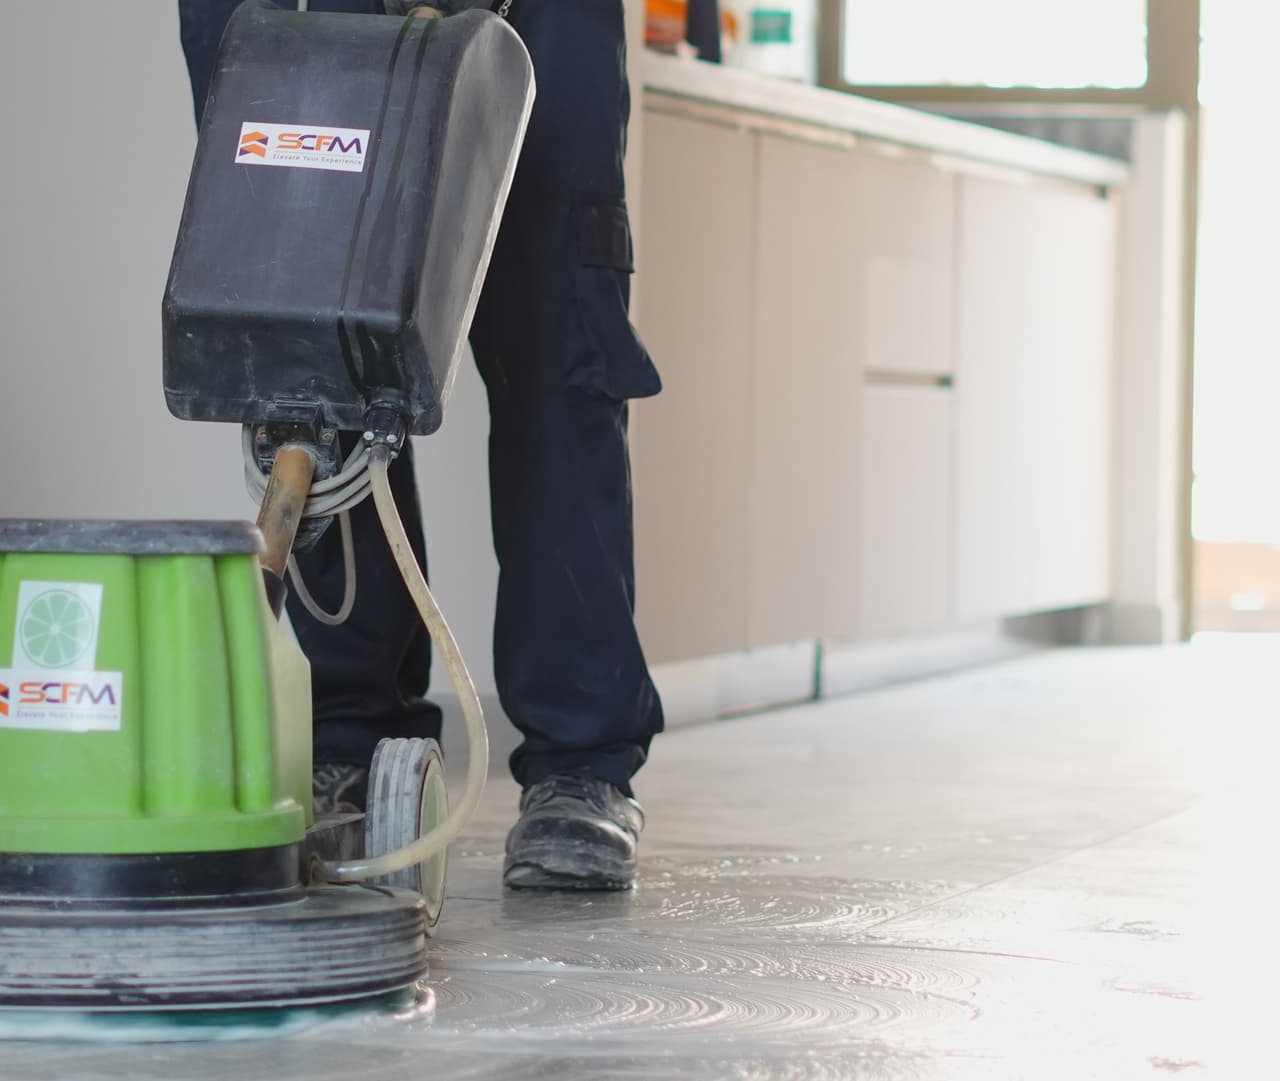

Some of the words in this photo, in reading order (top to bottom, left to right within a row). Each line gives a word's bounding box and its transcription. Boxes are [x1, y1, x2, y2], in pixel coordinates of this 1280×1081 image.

[276, 132, 362, 154] SCFM
[272, 153, 301, 161] Elevate
[321, 156, 362, 166] Experience
[19, 681, 117, 706] SCFM
